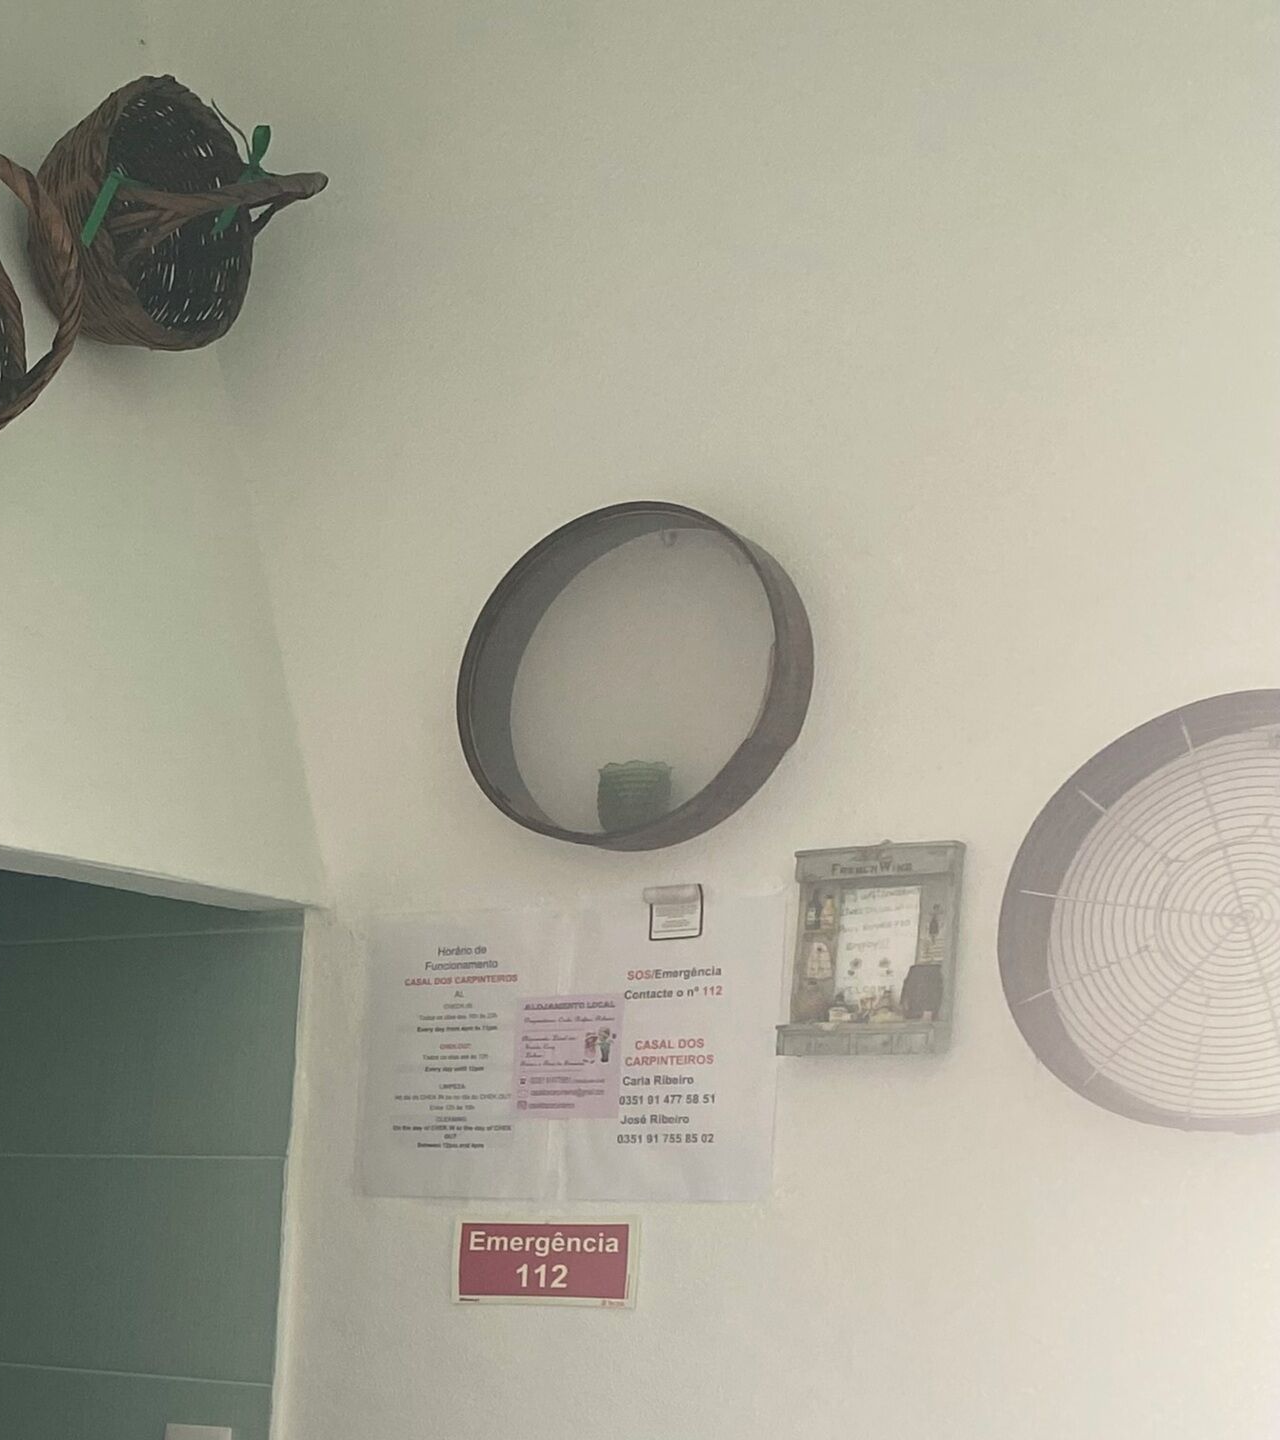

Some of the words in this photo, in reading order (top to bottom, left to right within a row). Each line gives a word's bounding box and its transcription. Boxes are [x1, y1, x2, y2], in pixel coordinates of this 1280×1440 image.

[438, 945, 472, 956] Horário
[474, 945, 487, 955] de
[425, 959, 498, 971] Funcionamento
[627, 966, 722, 980] SOS/Emergência
[404, 977, 432, 986] CASAL
[434, 976, 452, 985] DOS
[454, 974, 518, 984] CARPINTEIROS
[624, 989, 673, 1000] Contacte
[676, 989, 684, 997] o
[703, 985, 723, 996] 112
[635, 1039, 675, 1050] CASAL
[678, 1038, 705, 1049] DOS
[625, 1054, 715, 1066] CARPINTEIROS
[622, 1075, 651, 1086] Carla
[653, 1074, 695, 1085] Ribeiro
[618, 1095, 644, 1105] 0351
[663, 1094, 682, 1104] 477
[702, 1093, 716, 1104] 51
[620, 1114, 647, 1125] José
[649, 1114, 690, 1124] Ribeiro
[616, 1134, 643, 1144] 0351
[663, 1133, 682, 1143] 755
[700, 1133, 715, 1143] 02
[469, 1231, 619, 1257] Emergência
[516, 1263, 569, 1288] 112
